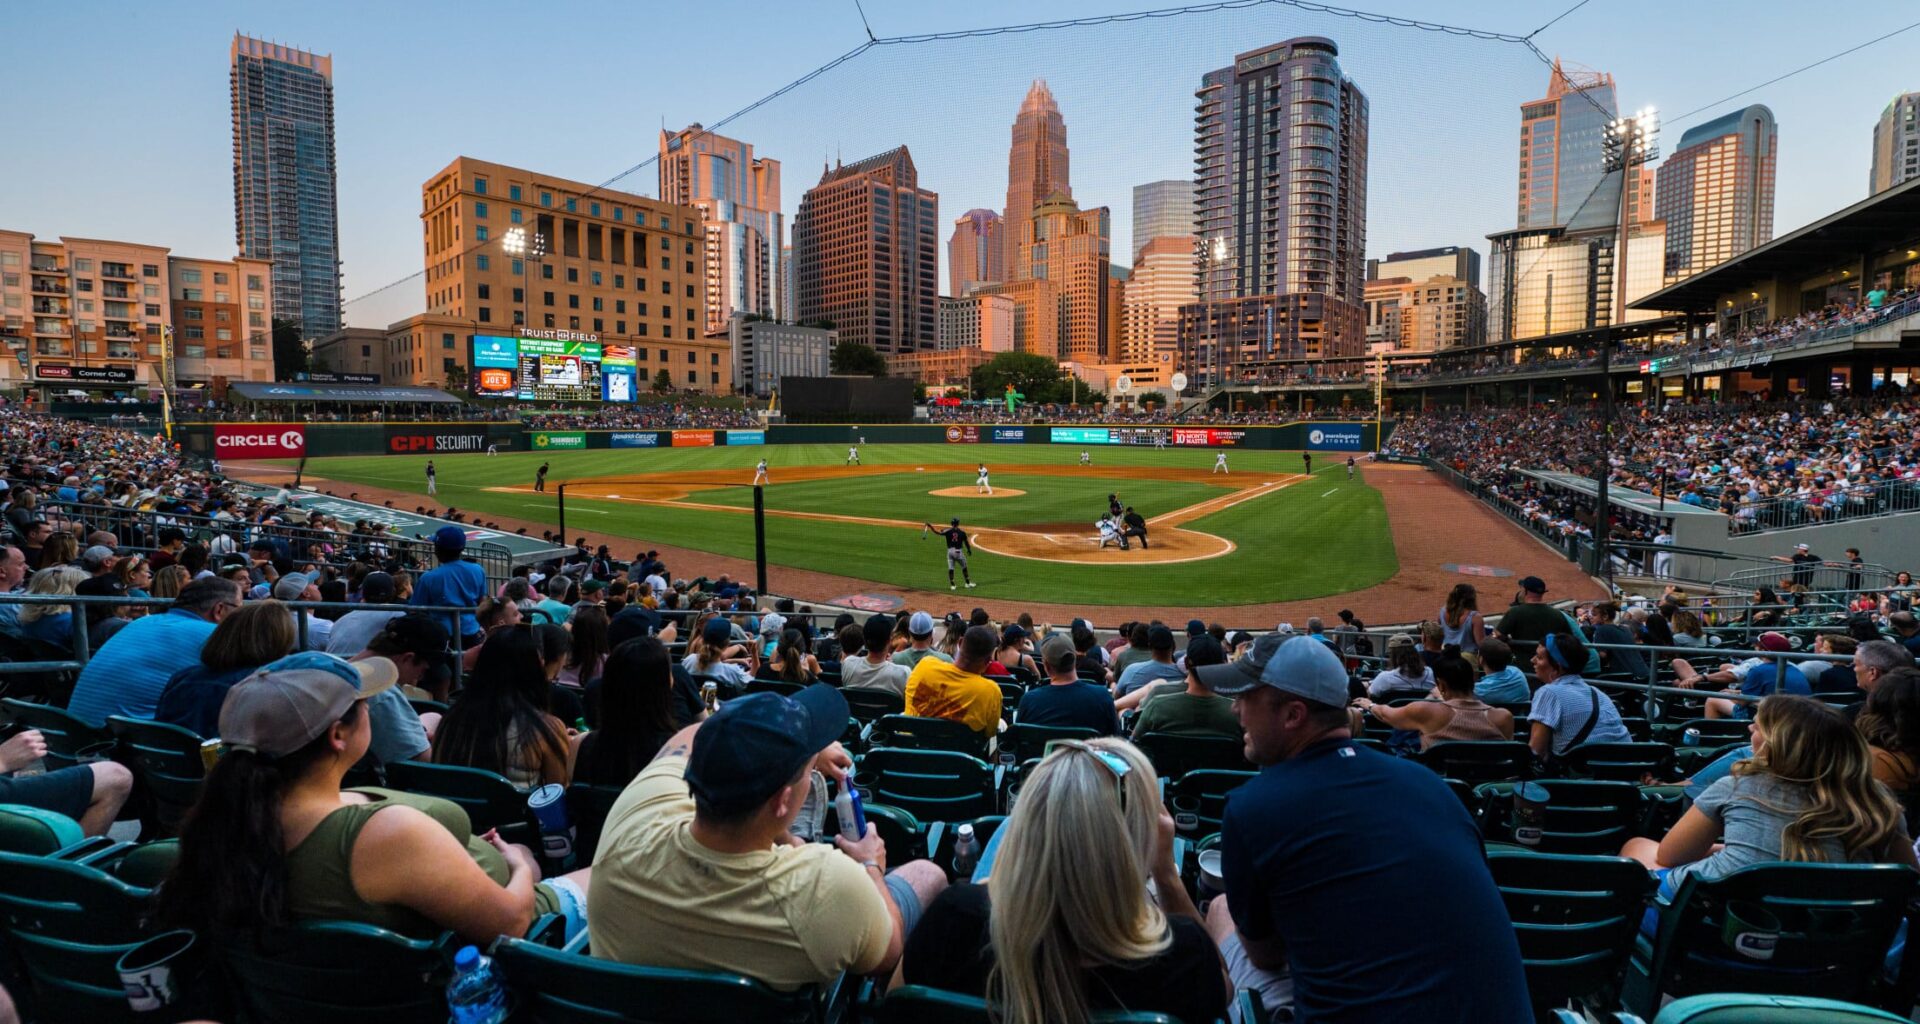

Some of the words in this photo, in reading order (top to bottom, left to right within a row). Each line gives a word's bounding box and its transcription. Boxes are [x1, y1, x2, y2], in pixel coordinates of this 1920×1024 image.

[520, 328, 555, 339] TRUIST
[570, 332, 597, 342] FIELD
[79, 369, 106, 377] Corner
[485, 376, 507, 384] JOE'S
[216, 434, 277, 447] CIRCLE
[390, 435, 435, 452] CPI
[435, 435, 483, 450] SECURITY
[550, 436, 582, 444] SUNBELT
[1175, 433, 1185, 444] 10
